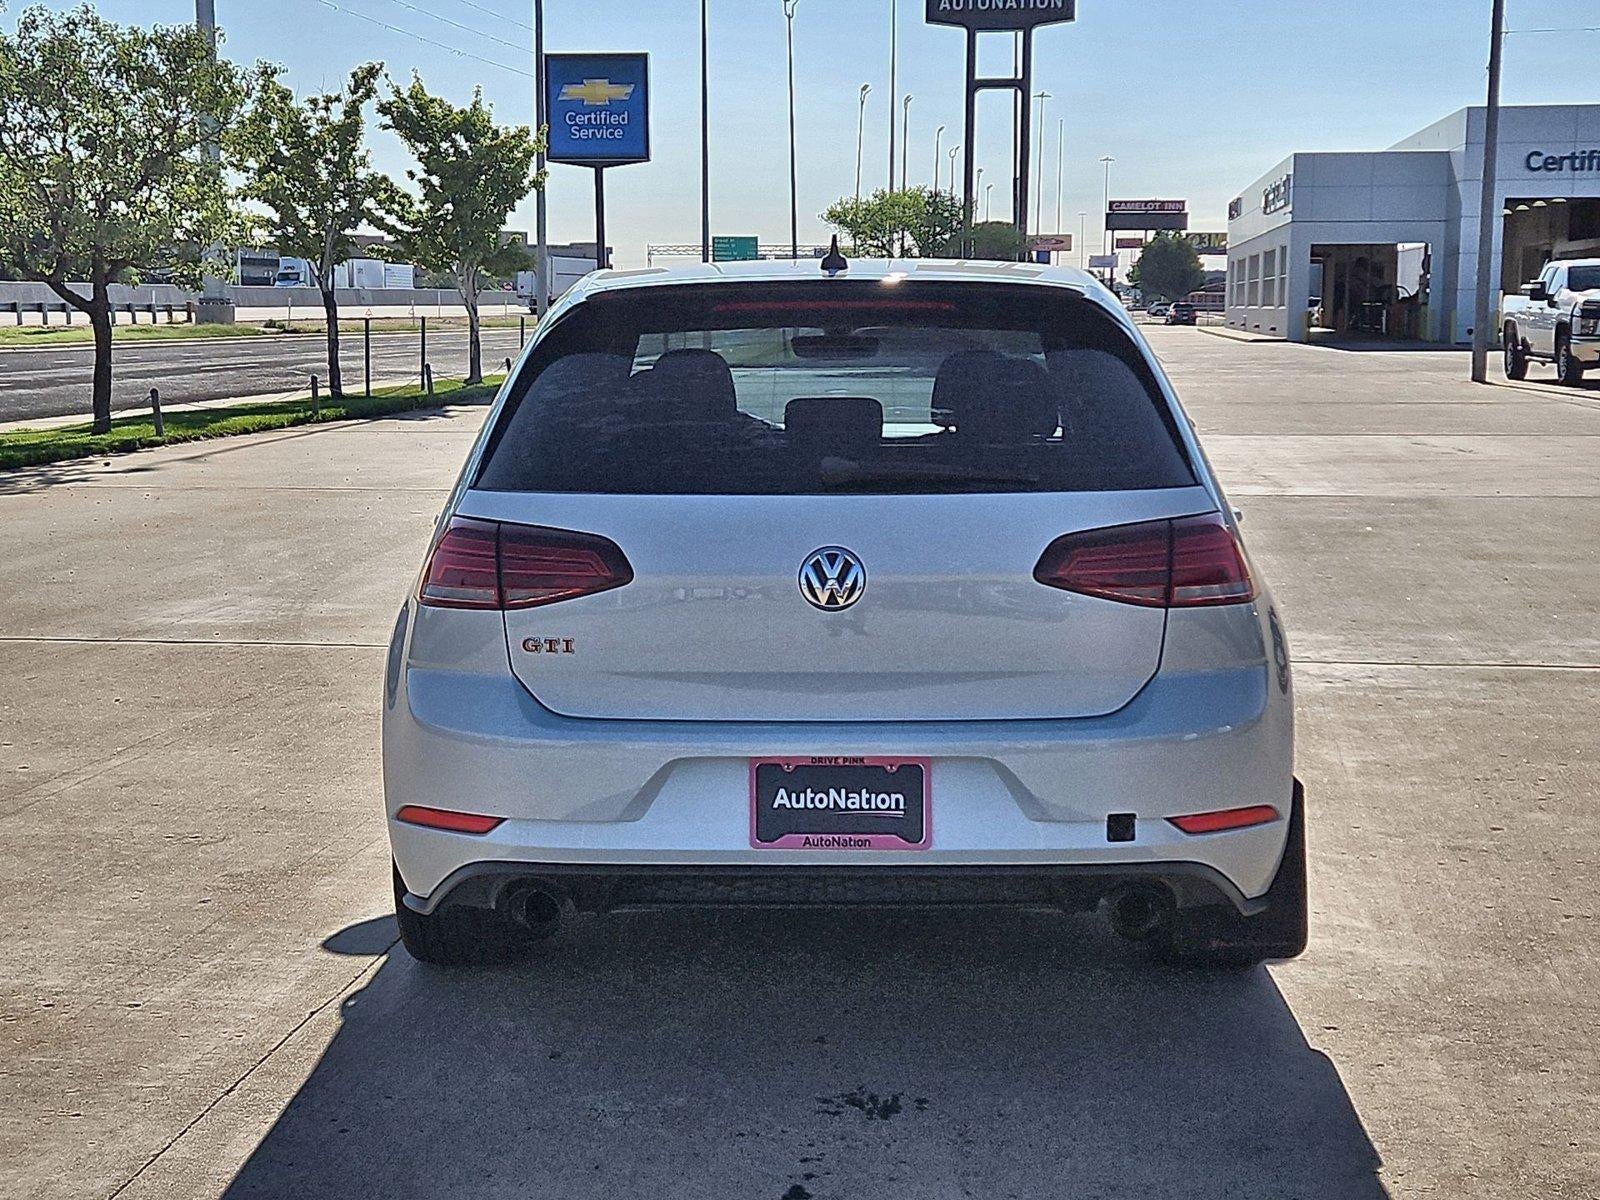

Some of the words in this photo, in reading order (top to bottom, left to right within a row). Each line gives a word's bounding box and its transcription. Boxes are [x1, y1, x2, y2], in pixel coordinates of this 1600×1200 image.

[565, 110, 628, 125] Certified
[570, 126, 624, 139] Service
[1112, 202, 1161, 210] CAMELOT
[1164, 202, 1183, 210] INN
[522, 637, 575, 654] GTI
[772, 787, 905, 809] AutoNation
[803, 836, 871, 848] AutoNation
